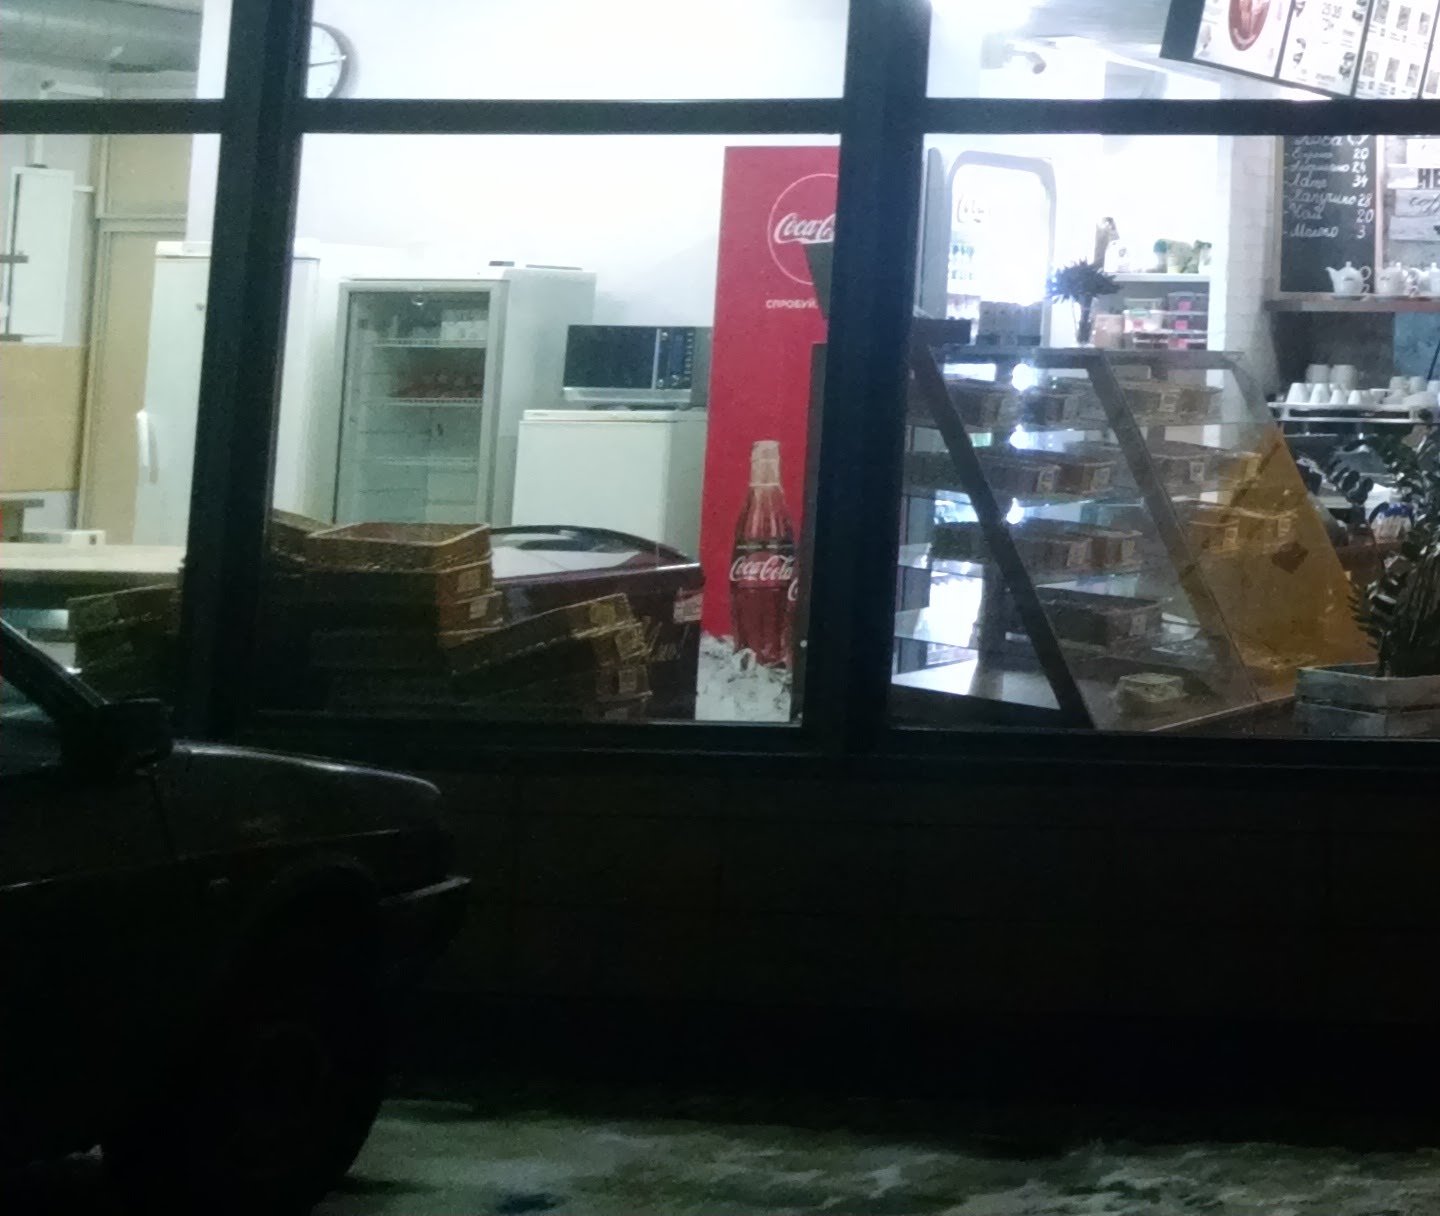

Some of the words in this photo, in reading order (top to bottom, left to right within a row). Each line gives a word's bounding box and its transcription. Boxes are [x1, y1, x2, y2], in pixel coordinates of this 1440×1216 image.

[1353, 147, 1369, 160] 20
[1352, 174, 1369, 188] 34
[1357, 193, 1373, 207] 28
[1356, 208, 1374, 223] 20
[773, 212, 836, 244] Coca-Co
[1356, 224, 1367, 239] 3
